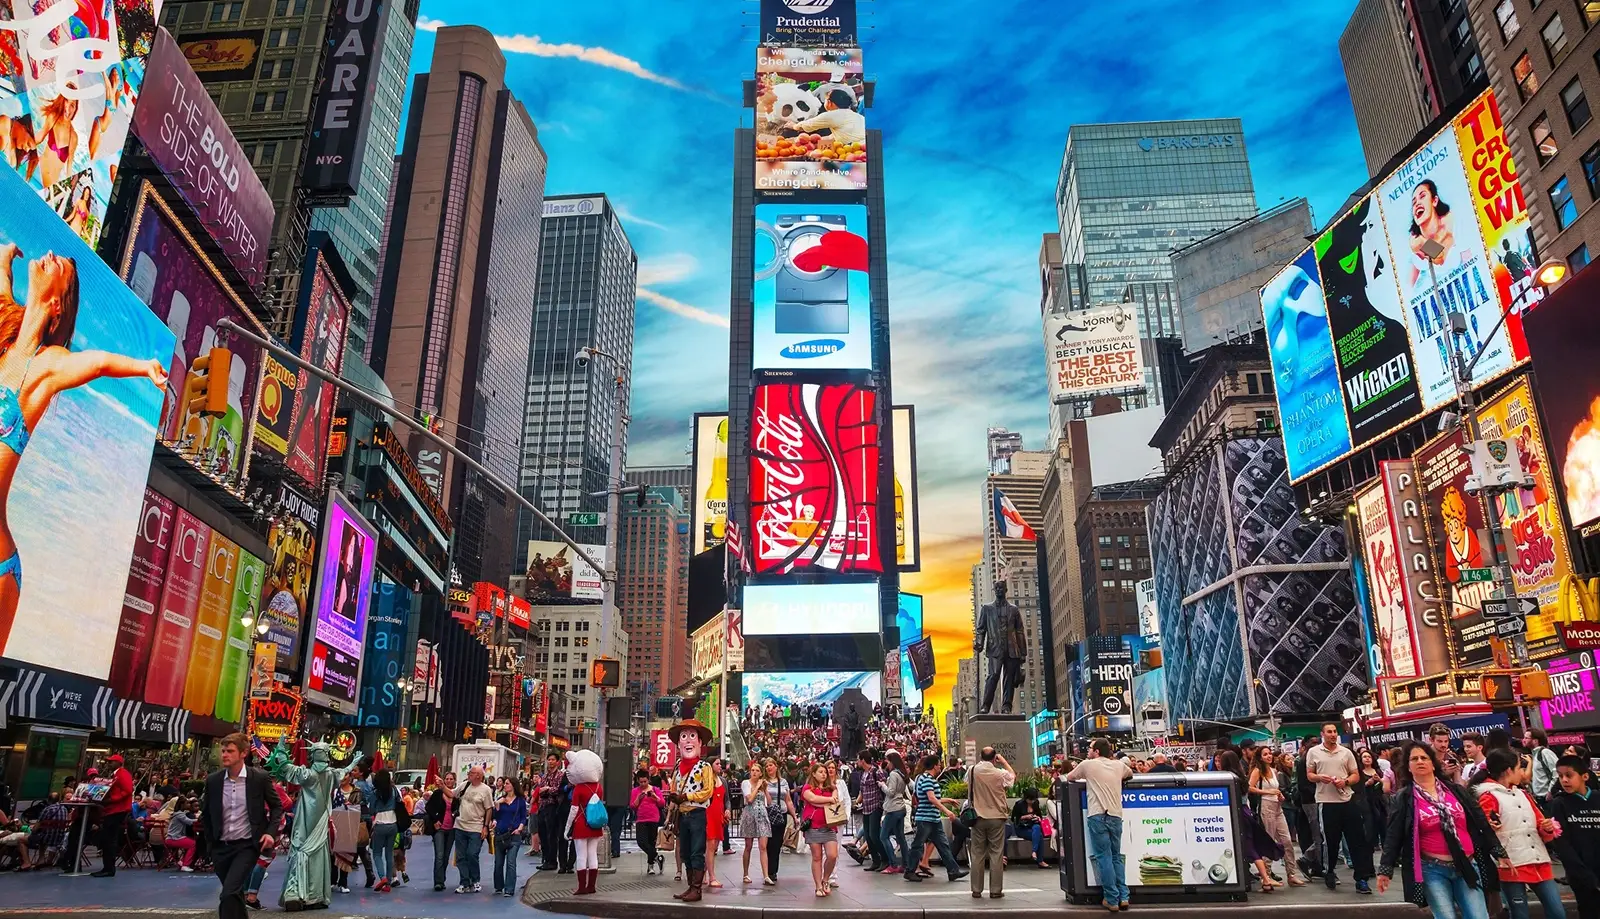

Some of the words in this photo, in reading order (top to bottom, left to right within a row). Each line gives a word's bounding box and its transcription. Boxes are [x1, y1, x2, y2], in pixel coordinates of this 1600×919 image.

[776, 16, 840, 27] Prudential
[760, 57, 818, 66] Chengdu,
[172, 74, 203, 138] THE
[200, 125, 240, 192] BOLD
[1158, 134, 1235, 150] BARCLAYS
[316, 155, 342, 166] NYC
[1398, 162, 1414, 182] THE
[1416, 144, 1433, 170] FUN
[772, 168, 798, 176] Where
[800, 168, 830, 176] Pandas
[832, 168, 852, 176] Live.
[1388, 175, 1414, 204] NEVER
[1416, 146, 1448, 180] STOPS!
[160, 112, 198, 188] SIDE
[198, 164, 218, 200] OF
[218, 190, 258, 264] WATER
[758, 178, 820, 188] Chengdu,
[542, 203, 574, 214] llianz
[1412, 265, 1490, 344] MAMMA
[1083, 314, 1132, 326] MORMON
[788, 345, 838, 353] SAMSUNG
[1056, 340, 1082, 350] WINNER
[1106, 334, 1134, 342] AWARDS
[1056, 348, 1082, 358] BEST
[1087, 342, 1135, 354] MUSICAL
[1340, 334, 1365, 354] BIGGEST
[1094, 350, 1136, 366] BEST
[1058, 366, 1116, 381] MUSICAL
[1119, 362, 1138, 373] OF
[1059, 380, 1084, 390] THIS
[260, 374, 282, 426] Q
[1302, 390, 1315, 404] The
[1286, 388, 1338, 431] PHANTOM
[1508, 398, 1521, 416] Jessie
[1505, 408, 1530, 432] MUELLER
[1298, 426, 1333, 454] OPERA
[1449, 458, 1459, 470] AND
[756, 406, 804, 552] Coca-Cola
[146, 489, 173, 510] SPARKLING
[280, 487, 286, 505] A
[286, 490, 302, 515] JOY
[300, 500, 320, 527] RIDE!
[707, 500, 726, 510] Coro
[1366, 500, 1382, 521] CAUSE
[137, 500, 171, 550] ICE
[579, 514, 588, 524] 46
[176, 522, 205, 570] ICE
[586, 547, 596, 556] By
[1398, 473, 1439, 626] PALACE
[209, 543, 234, 584] ICE
[238, 561, 260, 600] ICE
[580, 568, 590, 577] did
[1462, 571, 1470, 580] W
[1472, 570, 1480, 580] 46
[1452, 581, 1494, 617] Annie
[384, 616, 402, 626] Stanley
[1500, 624, 1510, 634] ONE
[1512, 620, 1522, 630] WAY
[1566, 630, 1600, 639] McDo
[312, 656, 326, 679] CNN
[1098, 664, 1132, 681] HERO
[1101, 686, 1117, 695] JUNE
[1118, 686, 1123, 694] 6
[1550, 673, 1580, 696] IMES
[62, 701, 78, 711] OPEN
[255, 700, 296, 720] ROXY
[1548, 692, 1595, 717] SQUARE
[150, 722, 164, 732] OPEN
[1370, 735, 1380, 744] BOX
[1380, 732, 1395, 742] OFFICE
[1396, 731, 1408, 741] HERE
[656, 733, 672, 764] tkts
[1138, 793, 1168, 802] Green
[1171, 793, 1190, 801] and
[1192, 792, 1223, 800] Clean!
[1142, 817, 1172, 825] recycle
[1193, 815, 1224, 824] recycle
[1195, 825, 1224, 833] bottles
[1146, 837, 1171, 845] paper
